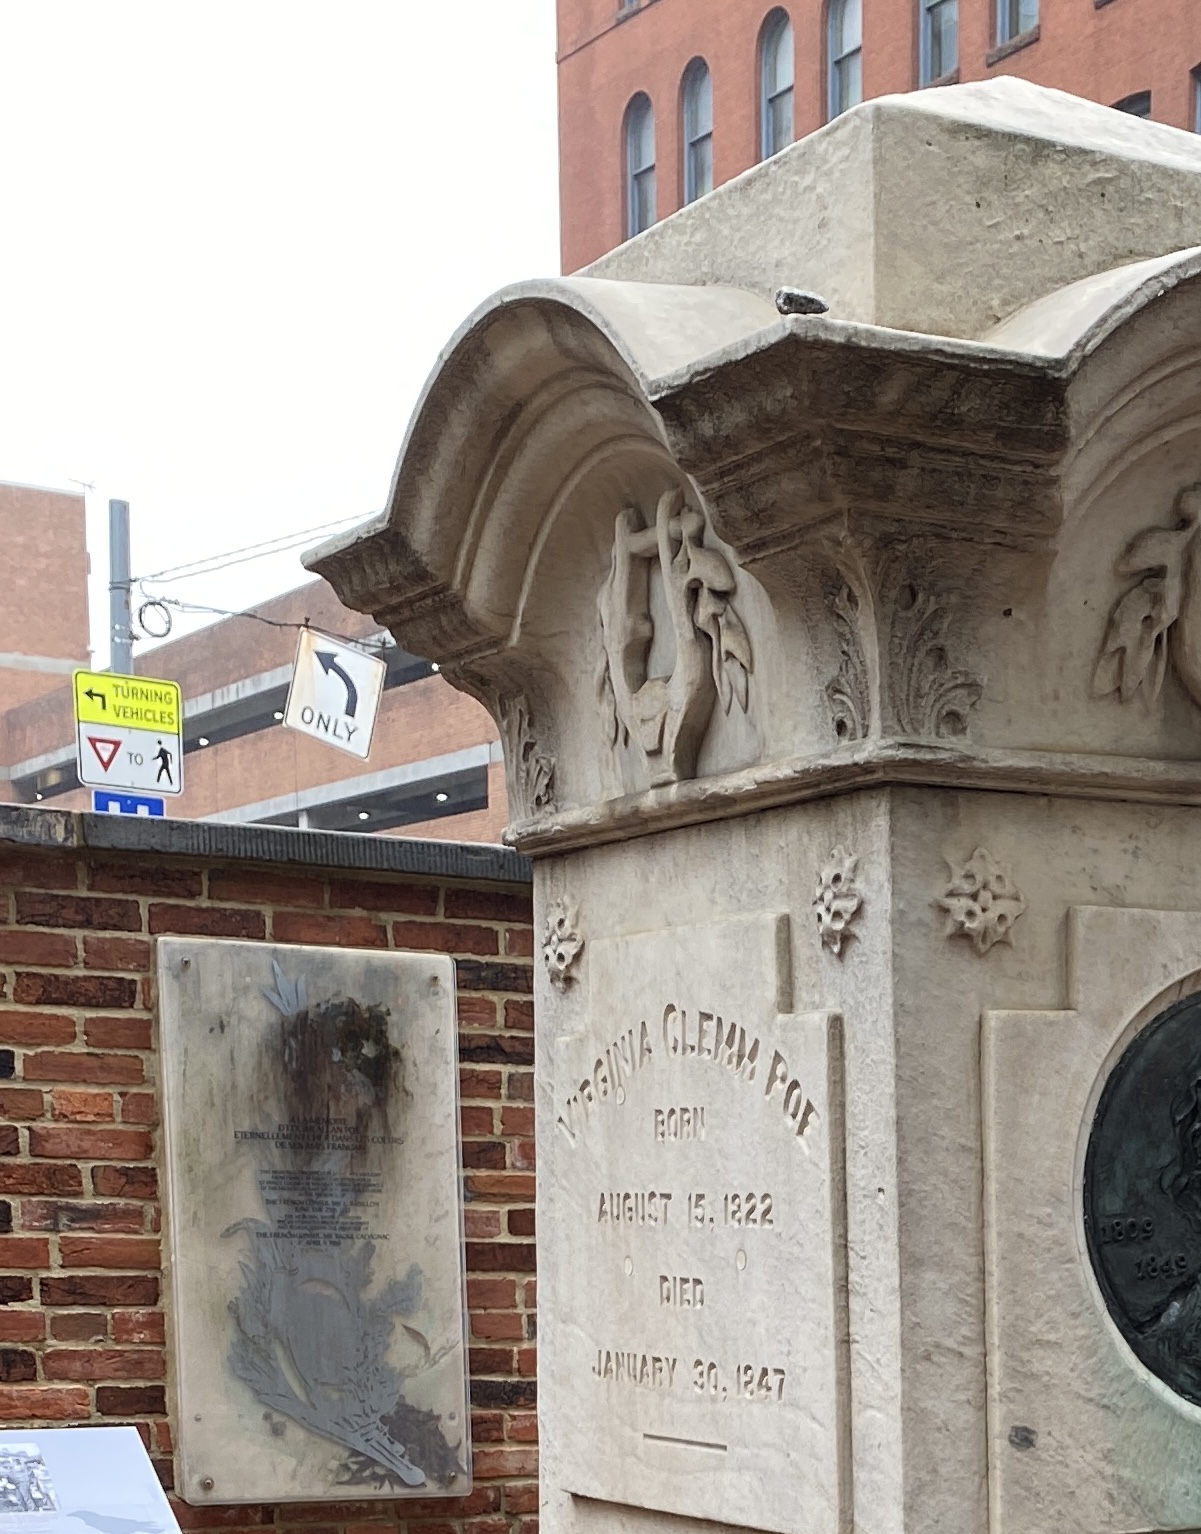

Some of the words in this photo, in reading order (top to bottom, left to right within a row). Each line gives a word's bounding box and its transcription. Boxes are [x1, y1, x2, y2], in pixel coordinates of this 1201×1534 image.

[112, 683, 173, 706] TURNING
[112, 703, 176, 726] VEHICLES
[301, 704, 359, 742] ONLY
[127, 751, 144, 767] TO
[556, 1020, 653, 1149] VIRGINIA
[662, 1002, 761, 1085] CLEMM
[764, 1048, 822, 1155] POE
[653, 1106, 706, 1144] BORN
[597, 1190, 673, 1227] AUGUST
[687, 1192, 715, 1232] 15,
[723, 1191, 774, 1229] 1822
[1101, 1215, 1155, 1245] 1809
[1135, 1252, 1188, 1281] 1849
[658, 1274, 705, 1310] DIED
[591, 1349, 678, 1389] JANUARY
[692, 1358, 728, 1403] 30,
[736, 1363, 787, 1402] 1847
